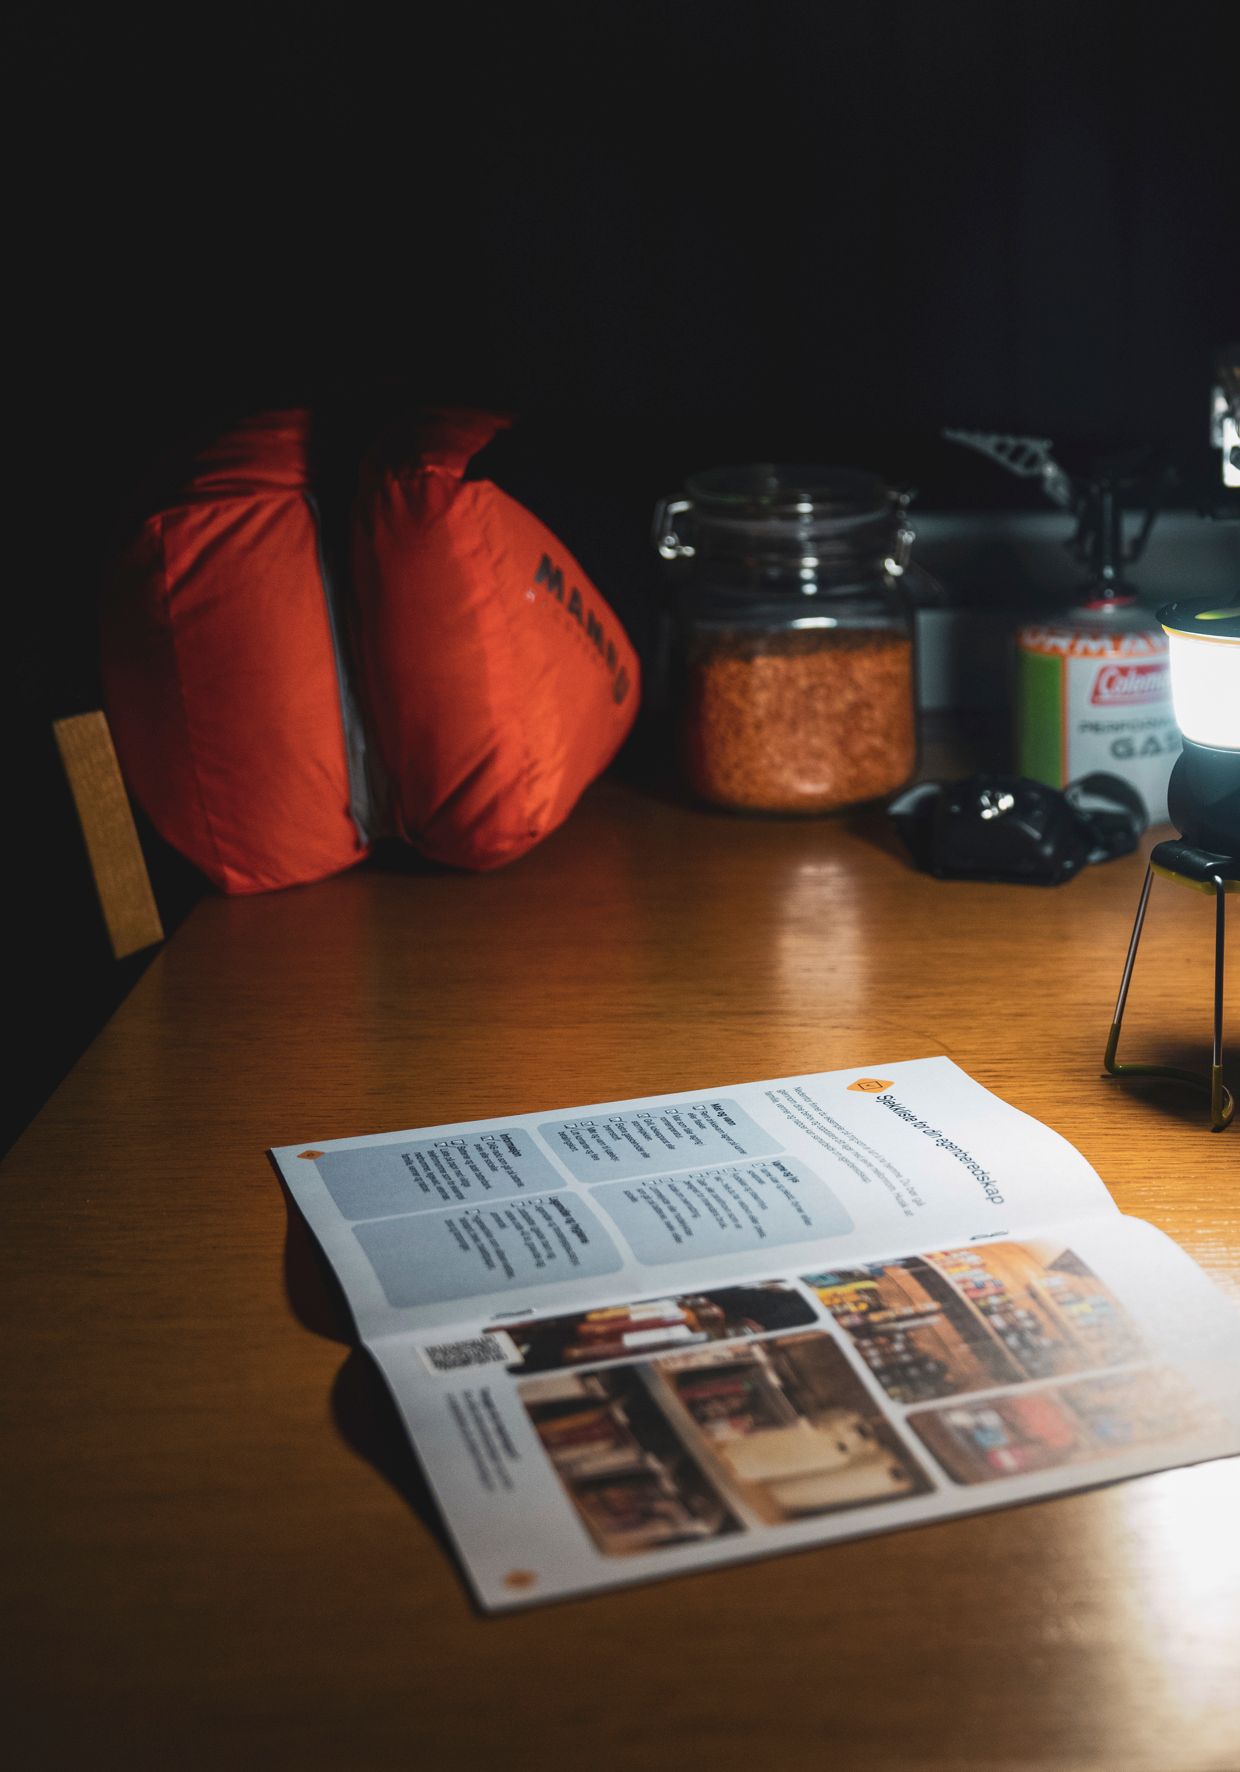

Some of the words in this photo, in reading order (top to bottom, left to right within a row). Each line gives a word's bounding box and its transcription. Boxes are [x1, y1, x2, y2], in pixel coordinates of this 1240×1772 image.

[710, 1103, 724, 1112] Mat
[722, 1116, 736, 1126] vann
[499, 1133, 522, 1157] Informasjon
[876, 1094, 917, 1122] Sjekkliste
[911, 1121, 930, 1129] for
[922, 1129, 943, 1139] din
[935, 1138, 1004, 1204] egenberedskap
